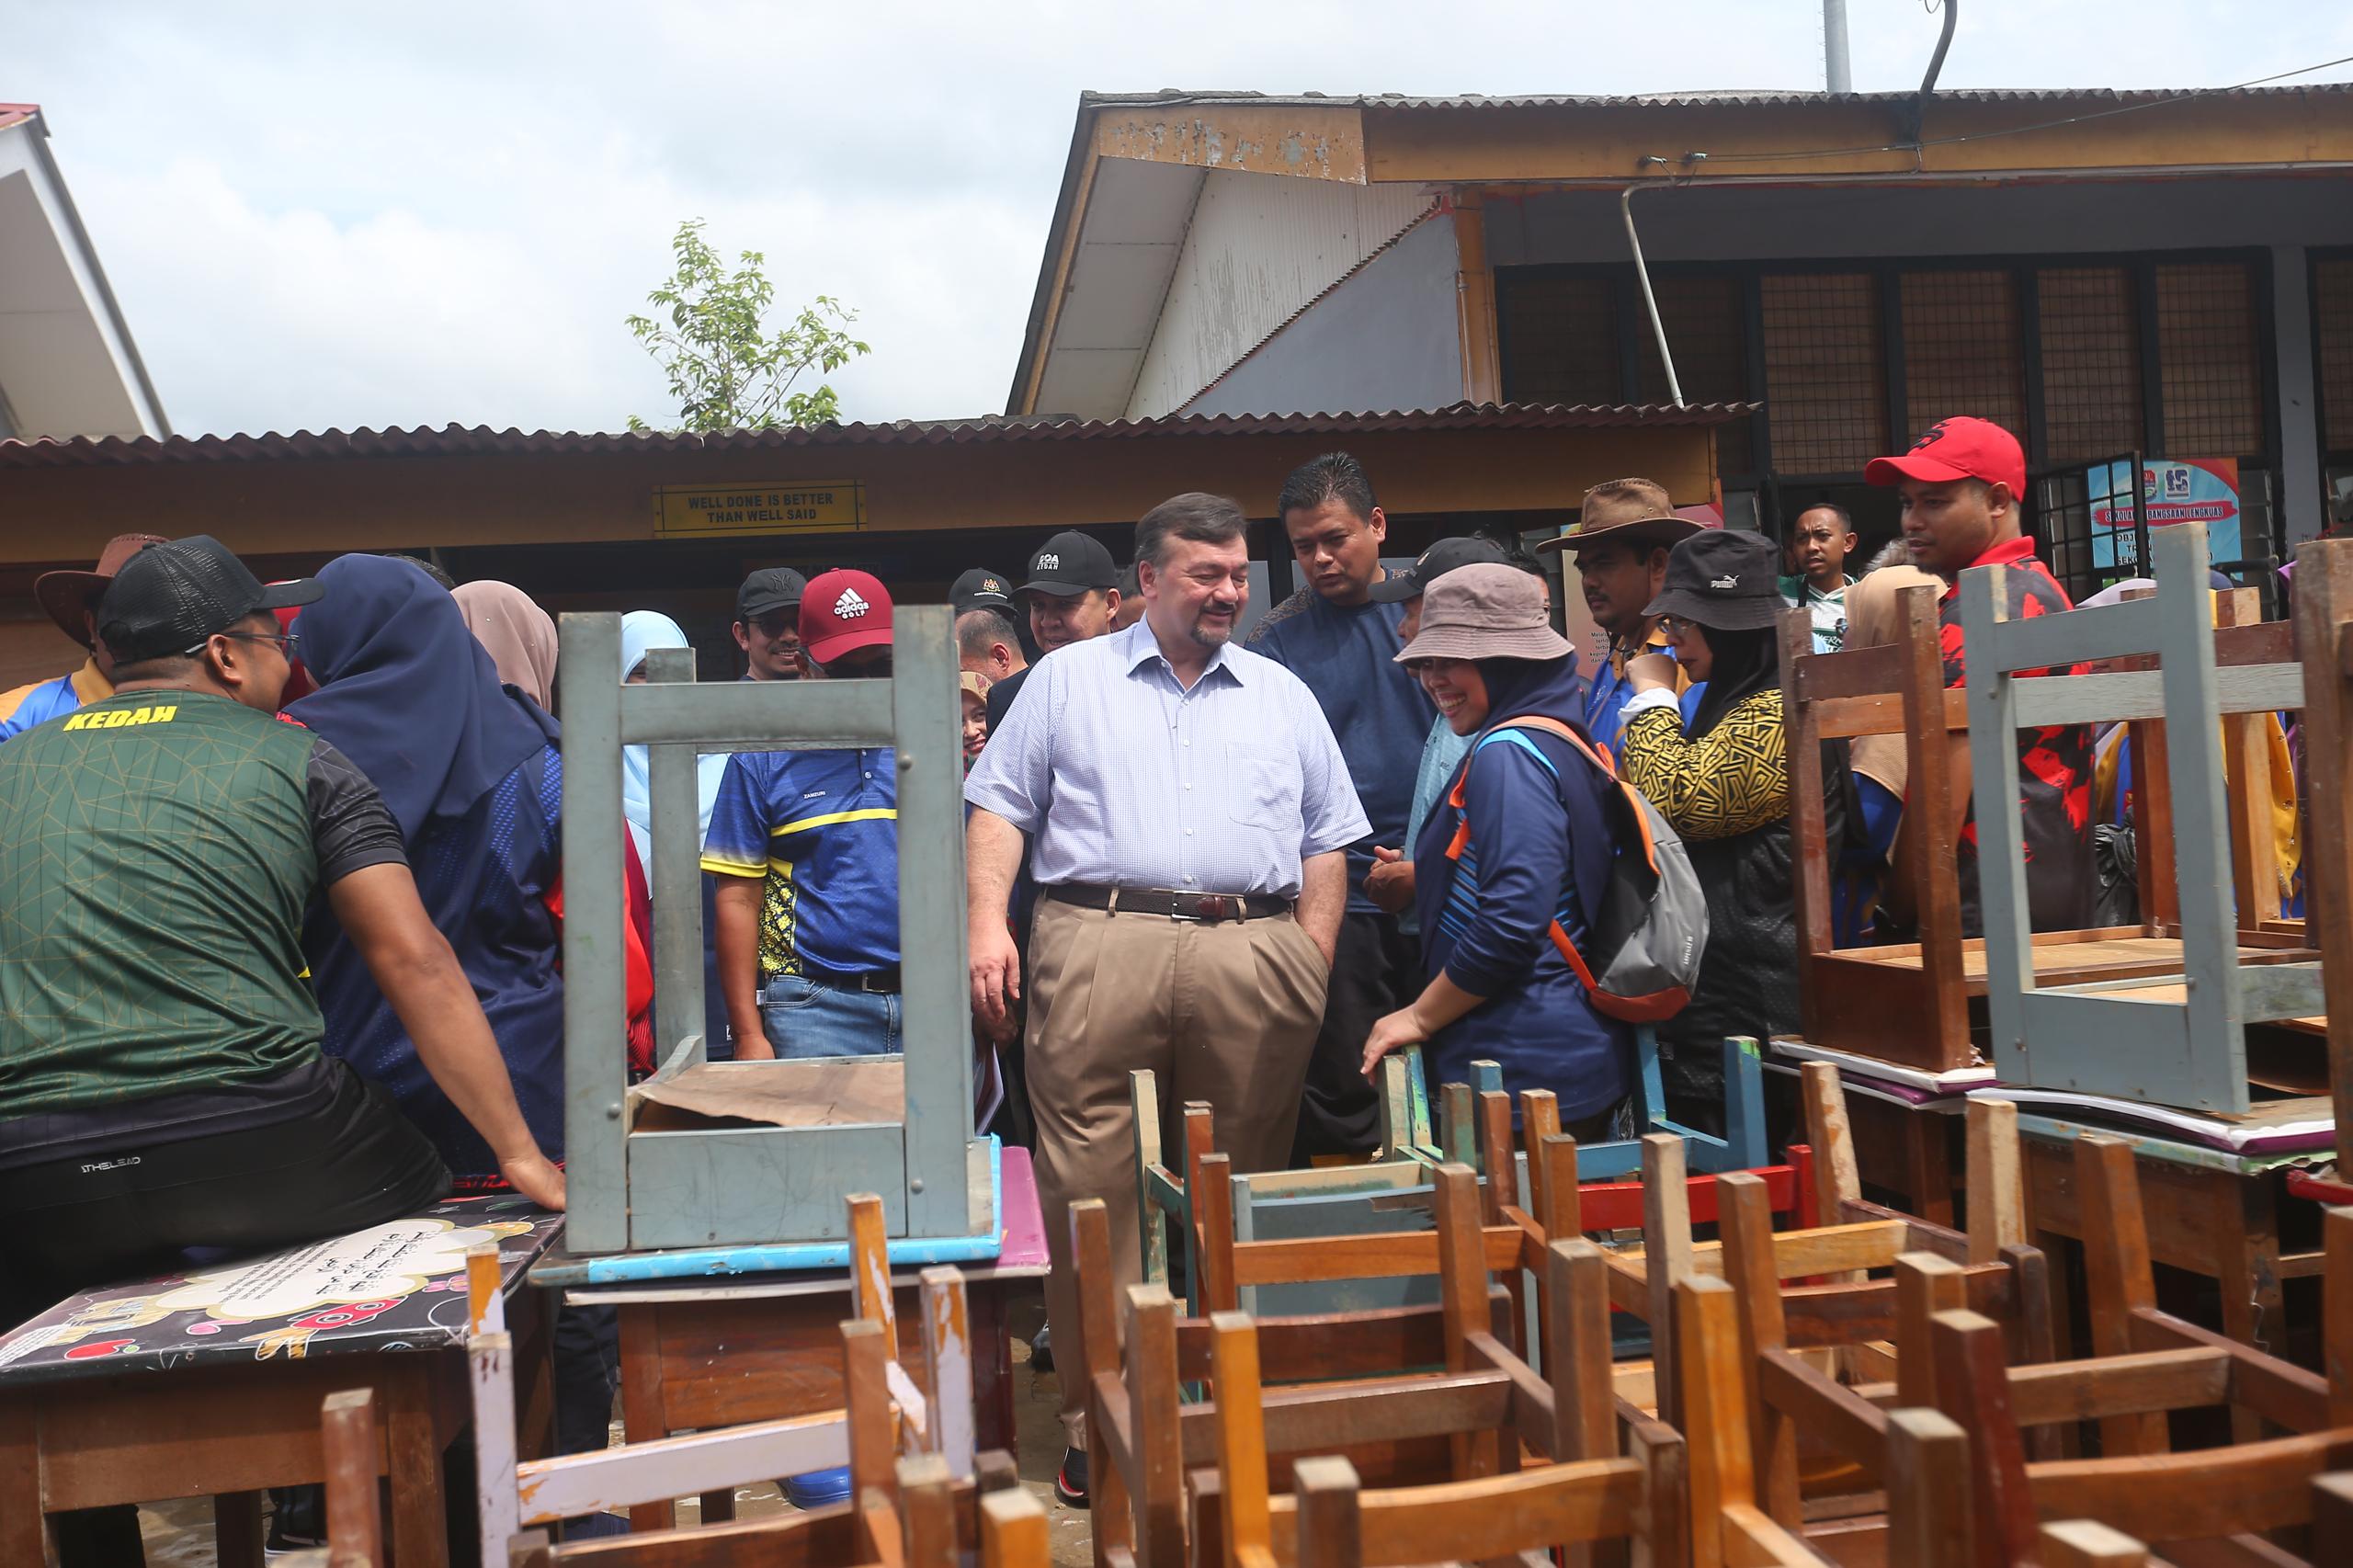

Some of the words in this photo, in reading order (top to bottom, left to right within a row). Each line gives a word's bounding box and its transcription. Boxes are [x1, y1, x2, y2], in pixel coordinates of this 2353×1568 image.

[688, 497, 722, 509] WELL
[727, 495, 763, 508] DONE
[767, 494, 780, 506] IS
[783, 493, 834, 506] BETTER
[707, 511, 743, 523] THAN
[746, 510, 783, 522] WELL
[787, 508, 817, 520] SAID
[834, 601, 870, 616] adidas
[841, 610, 866, 620] GOLF
[63, 706, 177, 732] KEDAH
